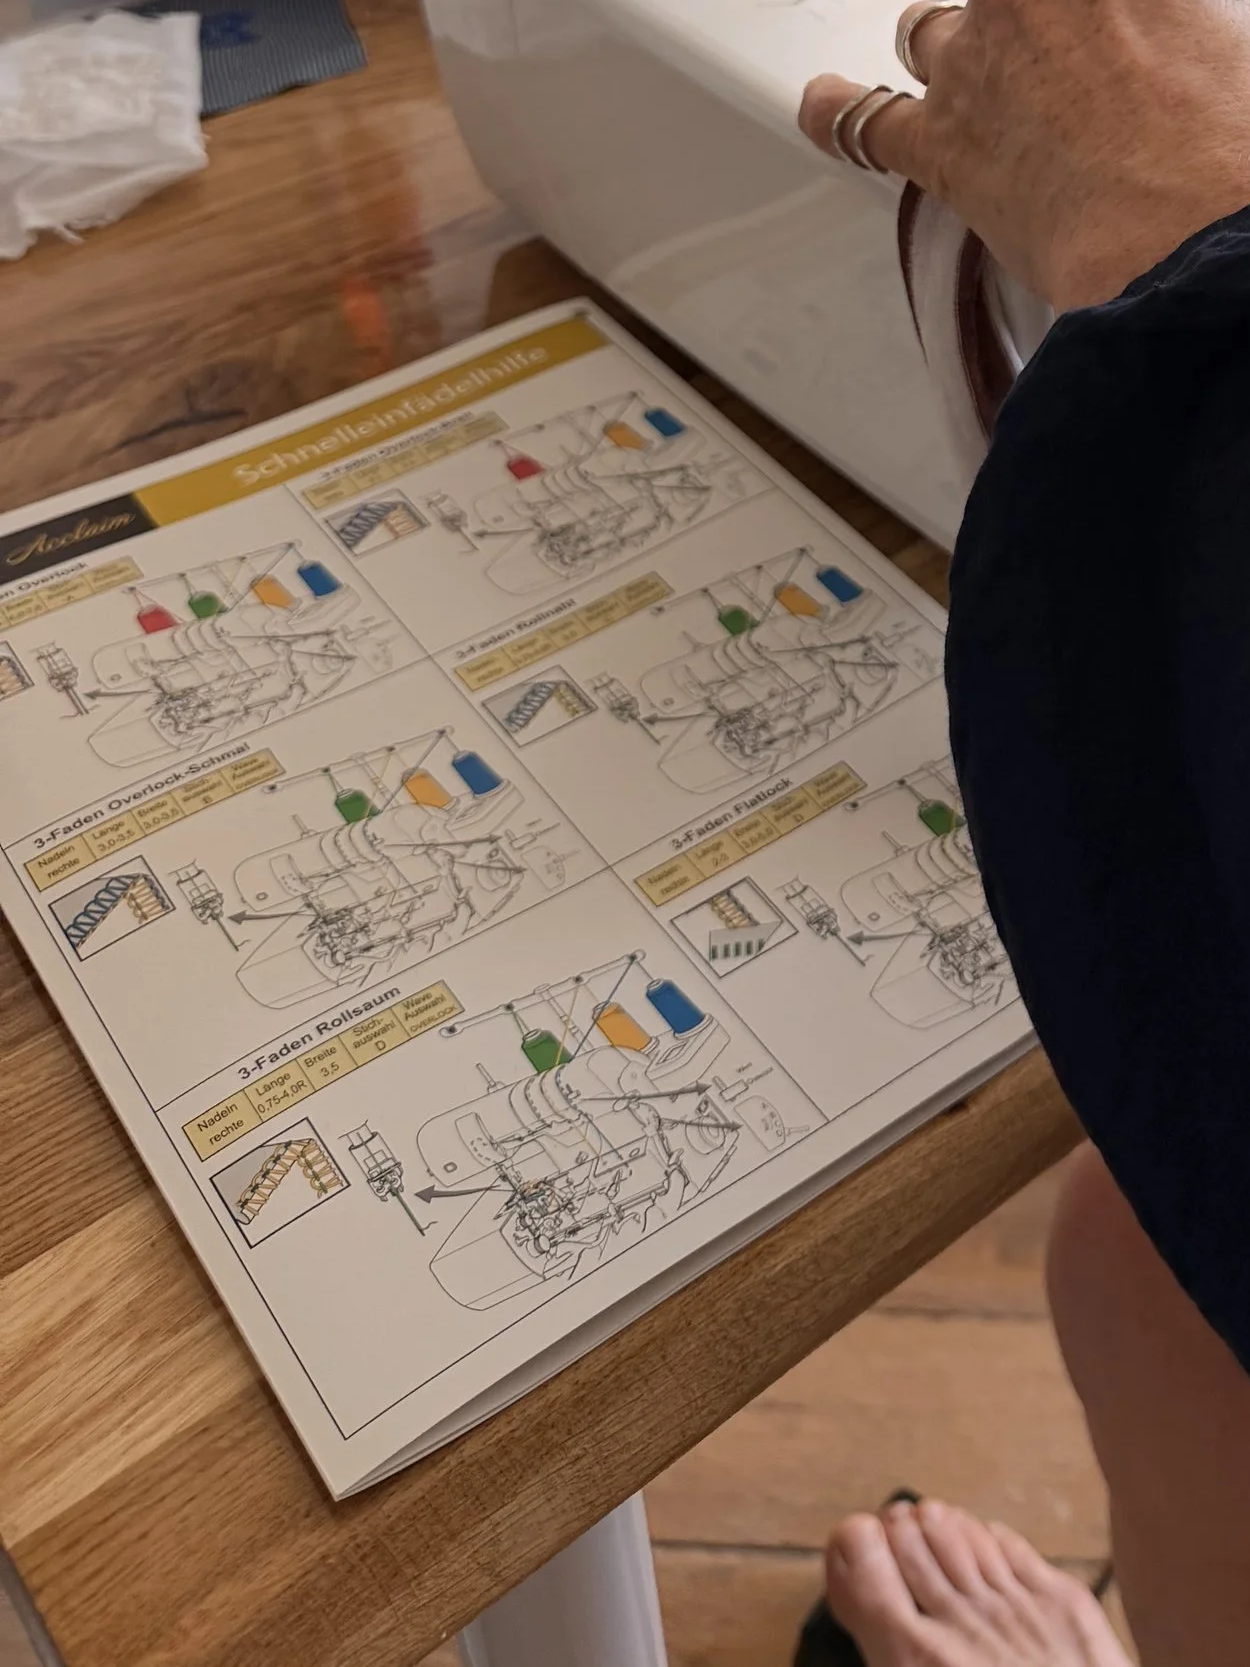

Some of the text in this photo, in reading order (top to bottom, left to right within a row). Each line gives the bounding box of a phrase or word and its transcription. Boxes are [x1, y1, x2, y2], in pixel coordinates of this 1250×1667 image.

[231, 345, 547, 485] Schnelleinfädelhilfe
[6, 512, 136, 566] Acclaim
[34, 809, 104, 849] 3-Faden
[108, 741, 251, 811] Overlock-Schmal
[670, 811, 732, 851] 3-Faden
[733, 776, 793, 815] Flatlock
[38, 845, 75, 868] Nadeln
[47, 857, 80, 878] rechte
[402, 992, 433, 1010] Wave
[405, 993, 446, 1021] Auswahl
[237, 986, 402, 1080] 3-Faden Rollsaum
[353, 1020, 396, 1049] auswahl
[375, 1040, 387, 1052] D
[304, 1045, 337, 1068] Breite
[320, 1061, 340, 1078] 3,5
[255, 1072, 291, 1097] Länge
[257, 1079, 308, 1114] 0,75-4,0R
[197, 1102, 238, 1132] Nadeln
[209, 1118, 244, 1146] rechte
